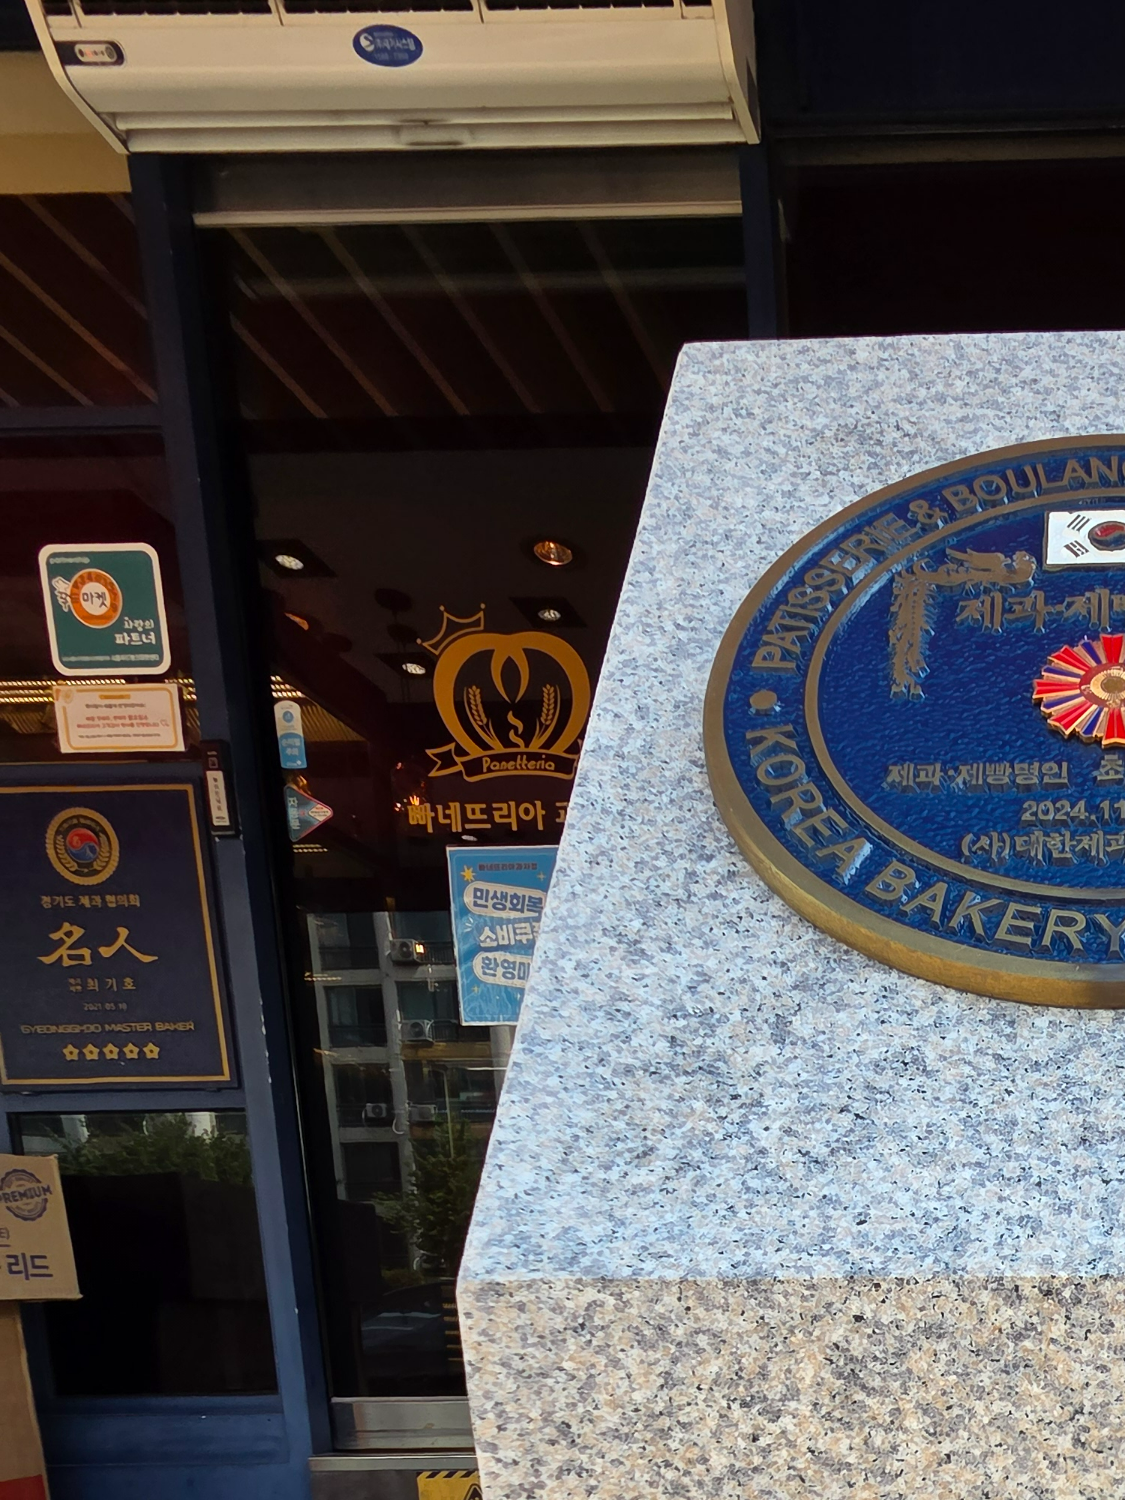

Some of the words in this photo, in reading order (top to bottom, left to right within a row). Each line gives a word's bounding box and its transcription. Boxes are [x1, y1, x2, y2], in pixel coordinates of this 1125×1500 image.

[752, 511, 921, 671] PATISSERIE
[908, 499, 949, 528] &
[82, 591, 109, 609] 마켓
[114, 632, 156, 645] 파트너
[482, 755, 555, 773] Panetteria
[746, 723, 873, 884] KOREA
[407, 800, 546, 833] 빠네뜨리아
[40, 895, 76, 909] 경기도
[473, 887, 544, 914] 민생회복
[37, 922, 159, 967] 名人
[104, 1022, 152, 1032] MASTER
[155, 1021, 195, 1031] BAKER
